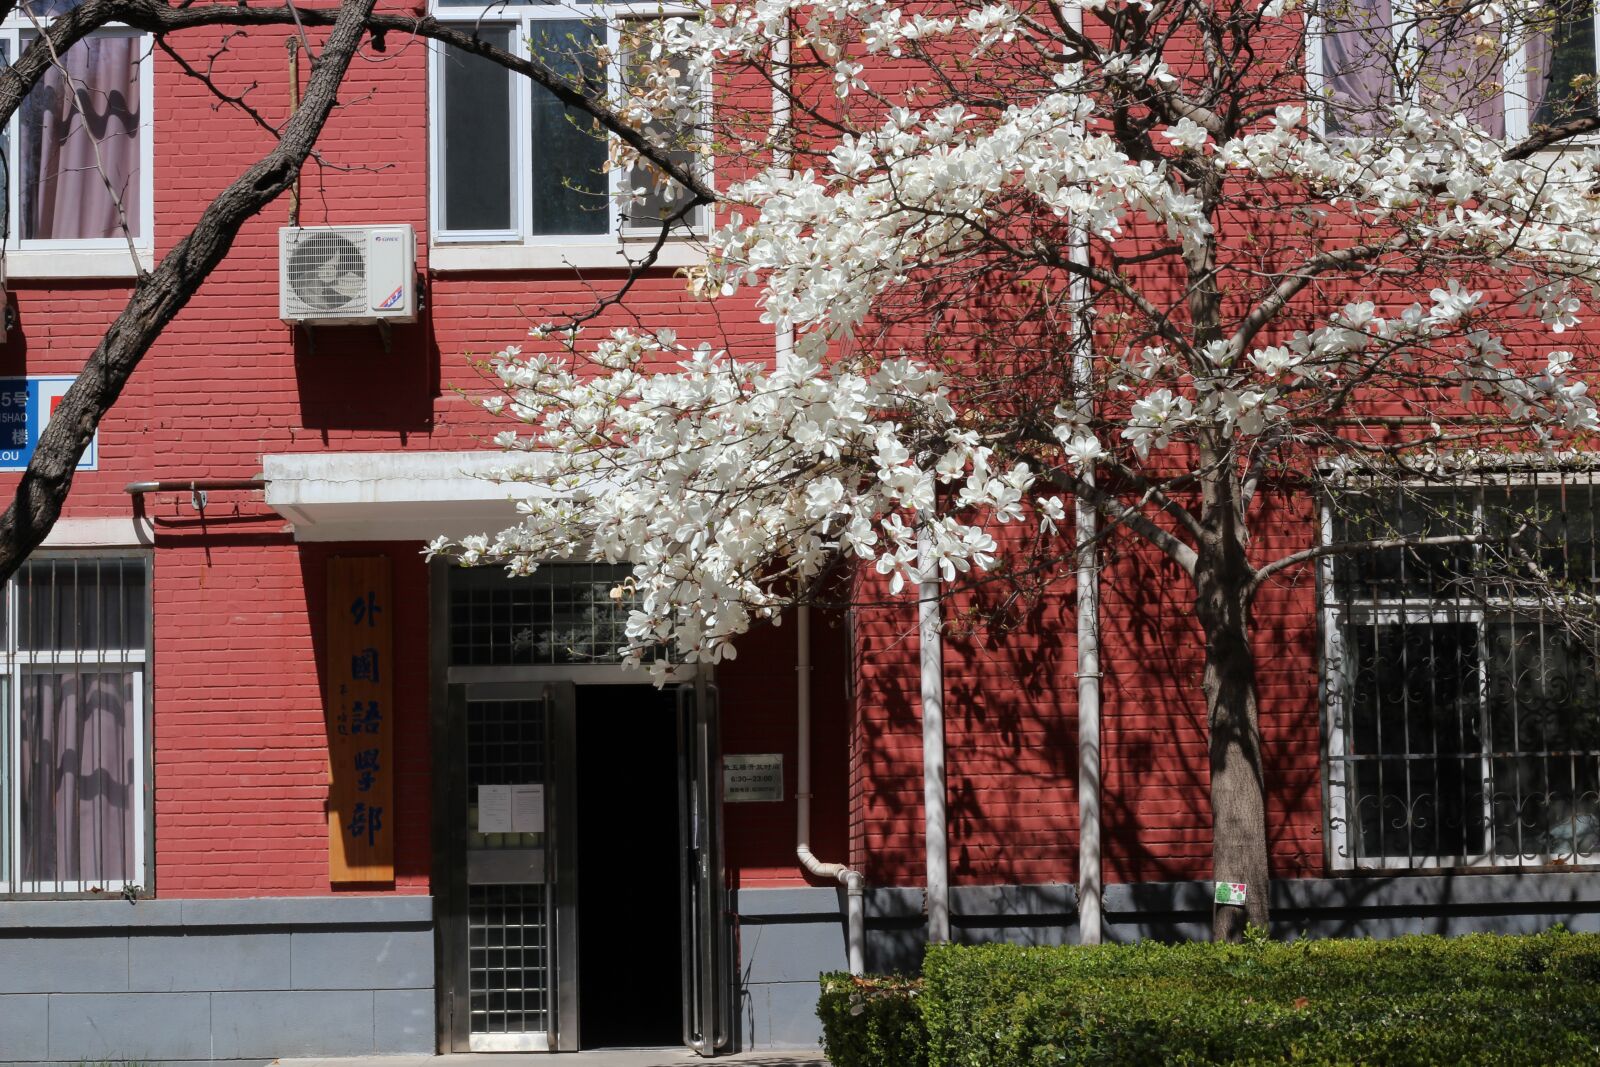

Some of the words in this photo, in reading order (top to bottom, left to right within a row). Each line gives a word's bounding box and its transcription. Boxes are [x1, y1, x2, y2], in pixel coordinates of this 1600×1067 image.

[0, 412, 28, 423] 5HAO
[12, 428, 28, 445] 楼
[0, 451, 19, 461] OU
